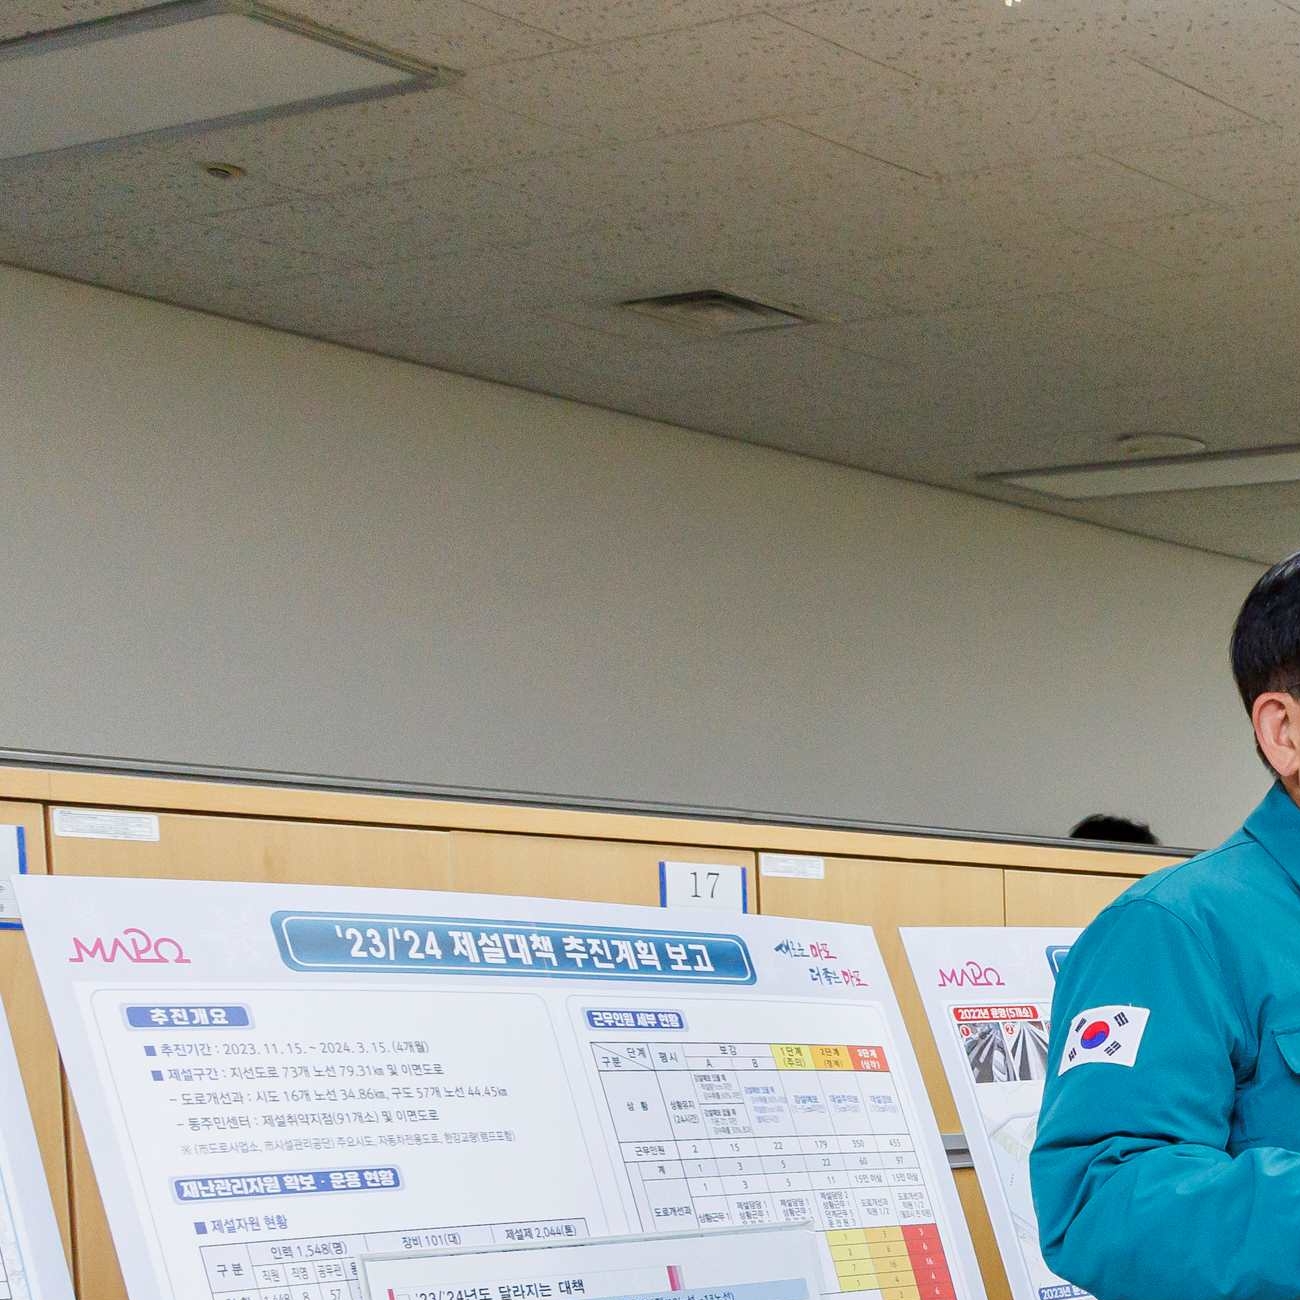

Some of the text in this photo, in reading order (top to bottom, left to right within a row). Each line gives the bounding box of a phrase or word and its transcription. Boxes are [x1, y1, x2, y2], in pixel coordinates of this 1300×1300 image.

[689, 871, 720, 899] 17
[69, 927, 192, 964] MAPO
[448, 930, 559, 967] 제설대책
[562, 936, 662, 971] 추진계획
[664, 942, 716, 972] 보고
[938, 960, 1006, 987] MAPO
[149, 1007, 230, 1026] 추진개요
[957, 1007, 990, 1020] 2022년
[161, 1042, 213, 1057] 추진기간
[168, 1067, 219, 1081] 제설구간
[230, 1066, 280, 1080] 지선도로
[312, 1065, 337, 1078] 노선
[386, 1063, 399, 1077] 및
[401, 1063, 445, 1076] 이면도로
[181, 1091, 244, 1106] 도로개선과
[188, 1115, 251, 1131] 동주민센터
[381, 1109, 393, 1123] 및
[395, 1108, 440, 1122] 이면도로
[180, 1168, 396, 1199] 재난관리자원 확보 운용 현황
[211, 1214, 288, 1234] 제설자원 현황
[402, 1232, 462, 1249] 장비 101(대)
[270, 1246, 294, 1260] 인력
[498, 1282, 552, 1300] 달라지는
[558, 1278, 586, 1296] 대책
[1041, 1285, 1072, 1300] 2023년
